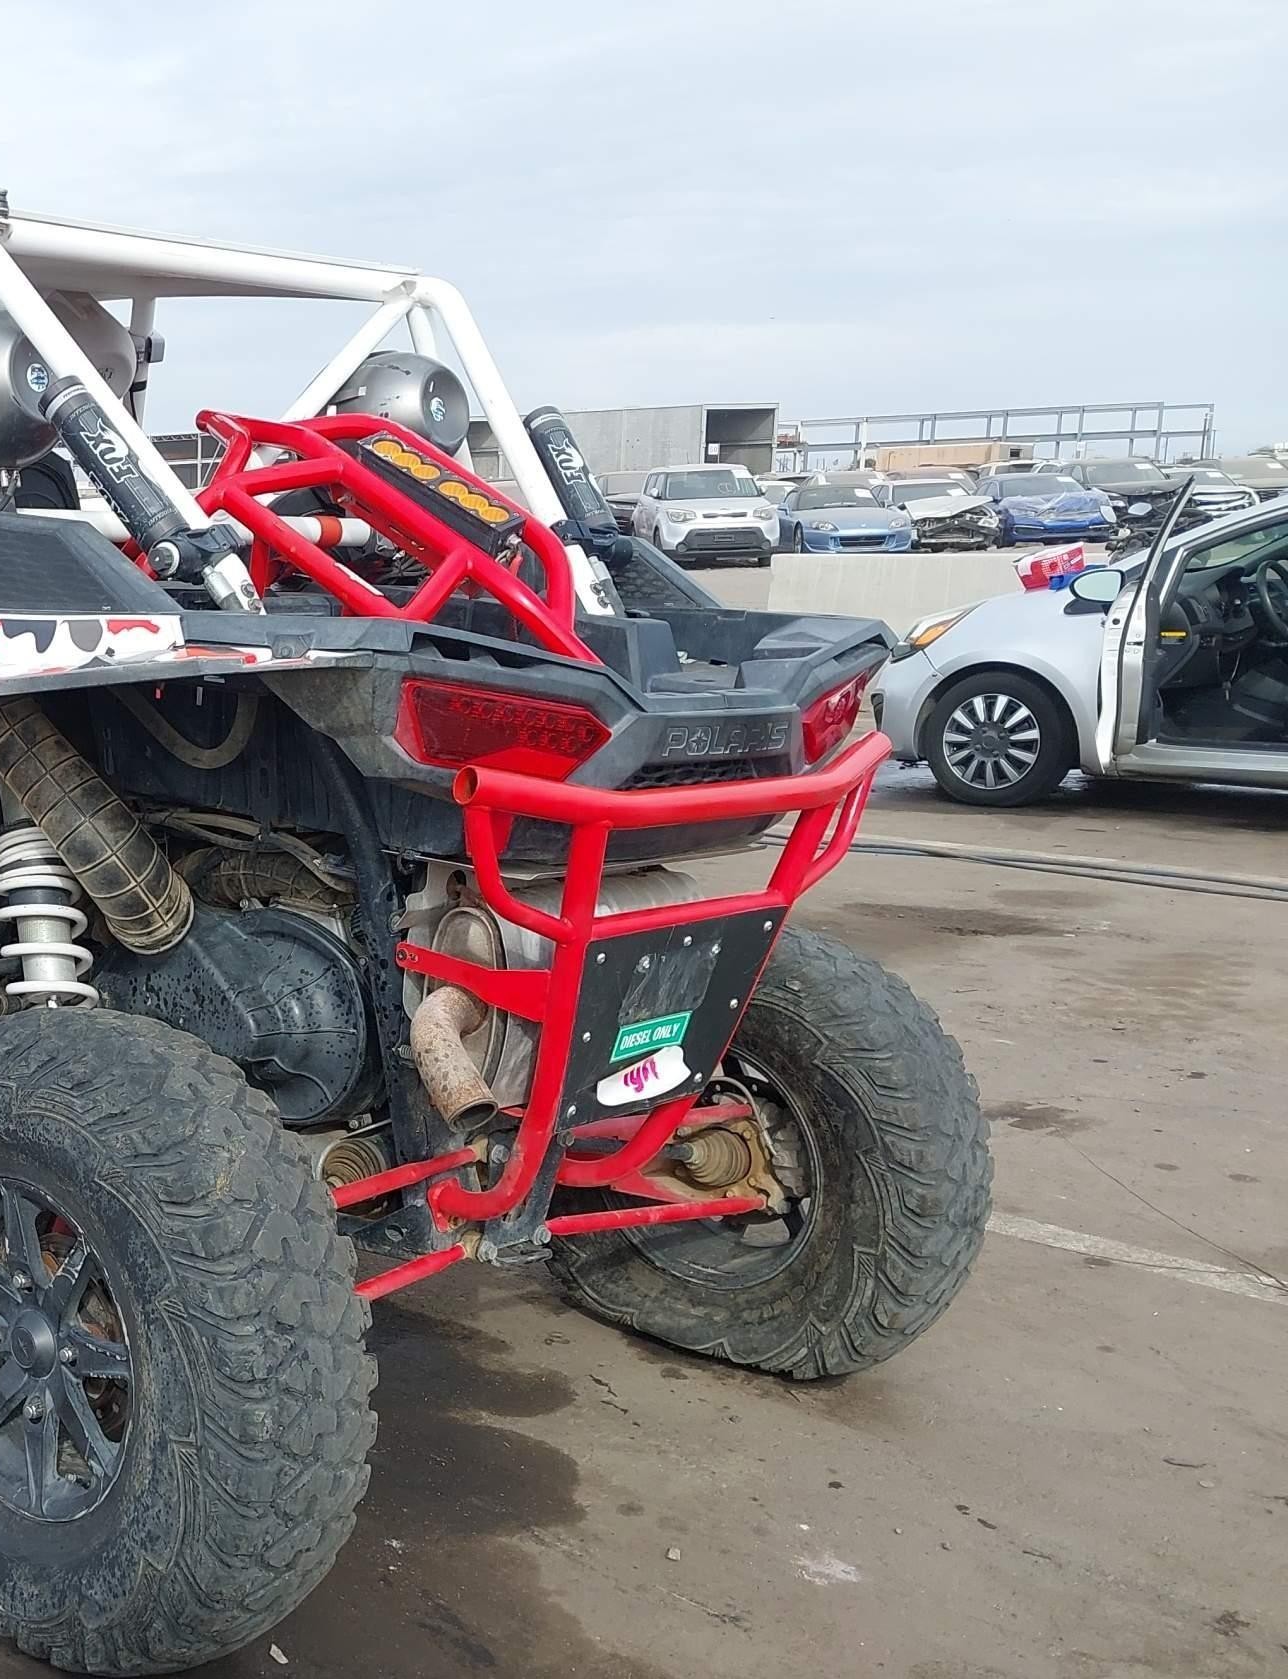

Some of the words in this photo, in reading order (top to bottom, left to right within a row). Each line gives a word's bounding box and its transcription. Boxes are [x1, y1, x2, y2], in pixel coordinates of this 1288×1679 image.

[80, 418, 139, 484] FOX
[548, 438, 587, 486] FOX
[661, 721, 789, 757] POLARIS
[620, 1029, 652, 1050] DIESEL
[652, 1022, 681, 1041] ONLY
